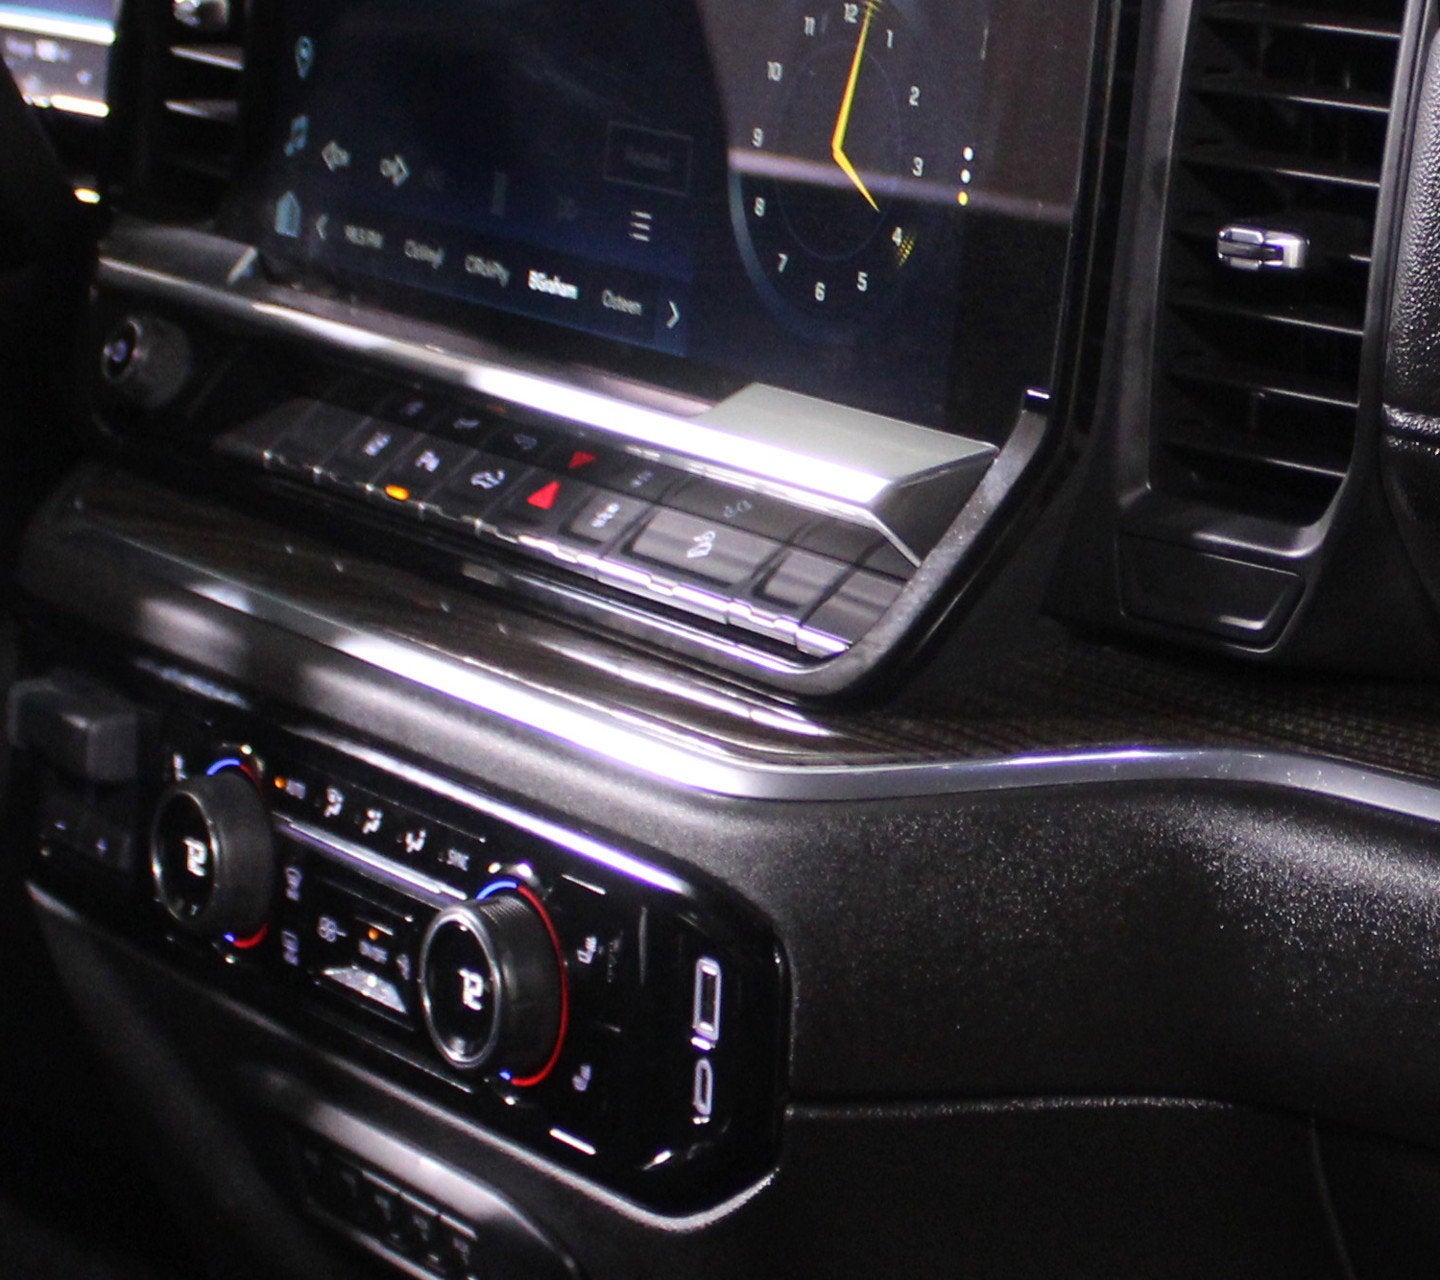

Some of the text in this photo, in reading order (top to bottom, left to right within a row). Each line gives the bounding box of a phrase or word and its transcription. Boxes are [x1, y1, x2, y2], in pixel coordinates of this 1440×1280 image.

[843, 3, 858, 23] 12
[804, 16, 815, 36] 11
[886, 29, 894, 48] 1
[767, 61, 782, 81] 10
[909, 86, 920, 106] 2
[752, 128, 763, 148] 9
[912, 157, 923, 177] 3
[754, 198, 765, 217] 8
[891, 227, 903, 247] 4
[777, 253, 788, 273] 7
[815, 281, 825, 302] 6
[857, 272, 868, 292] 5
